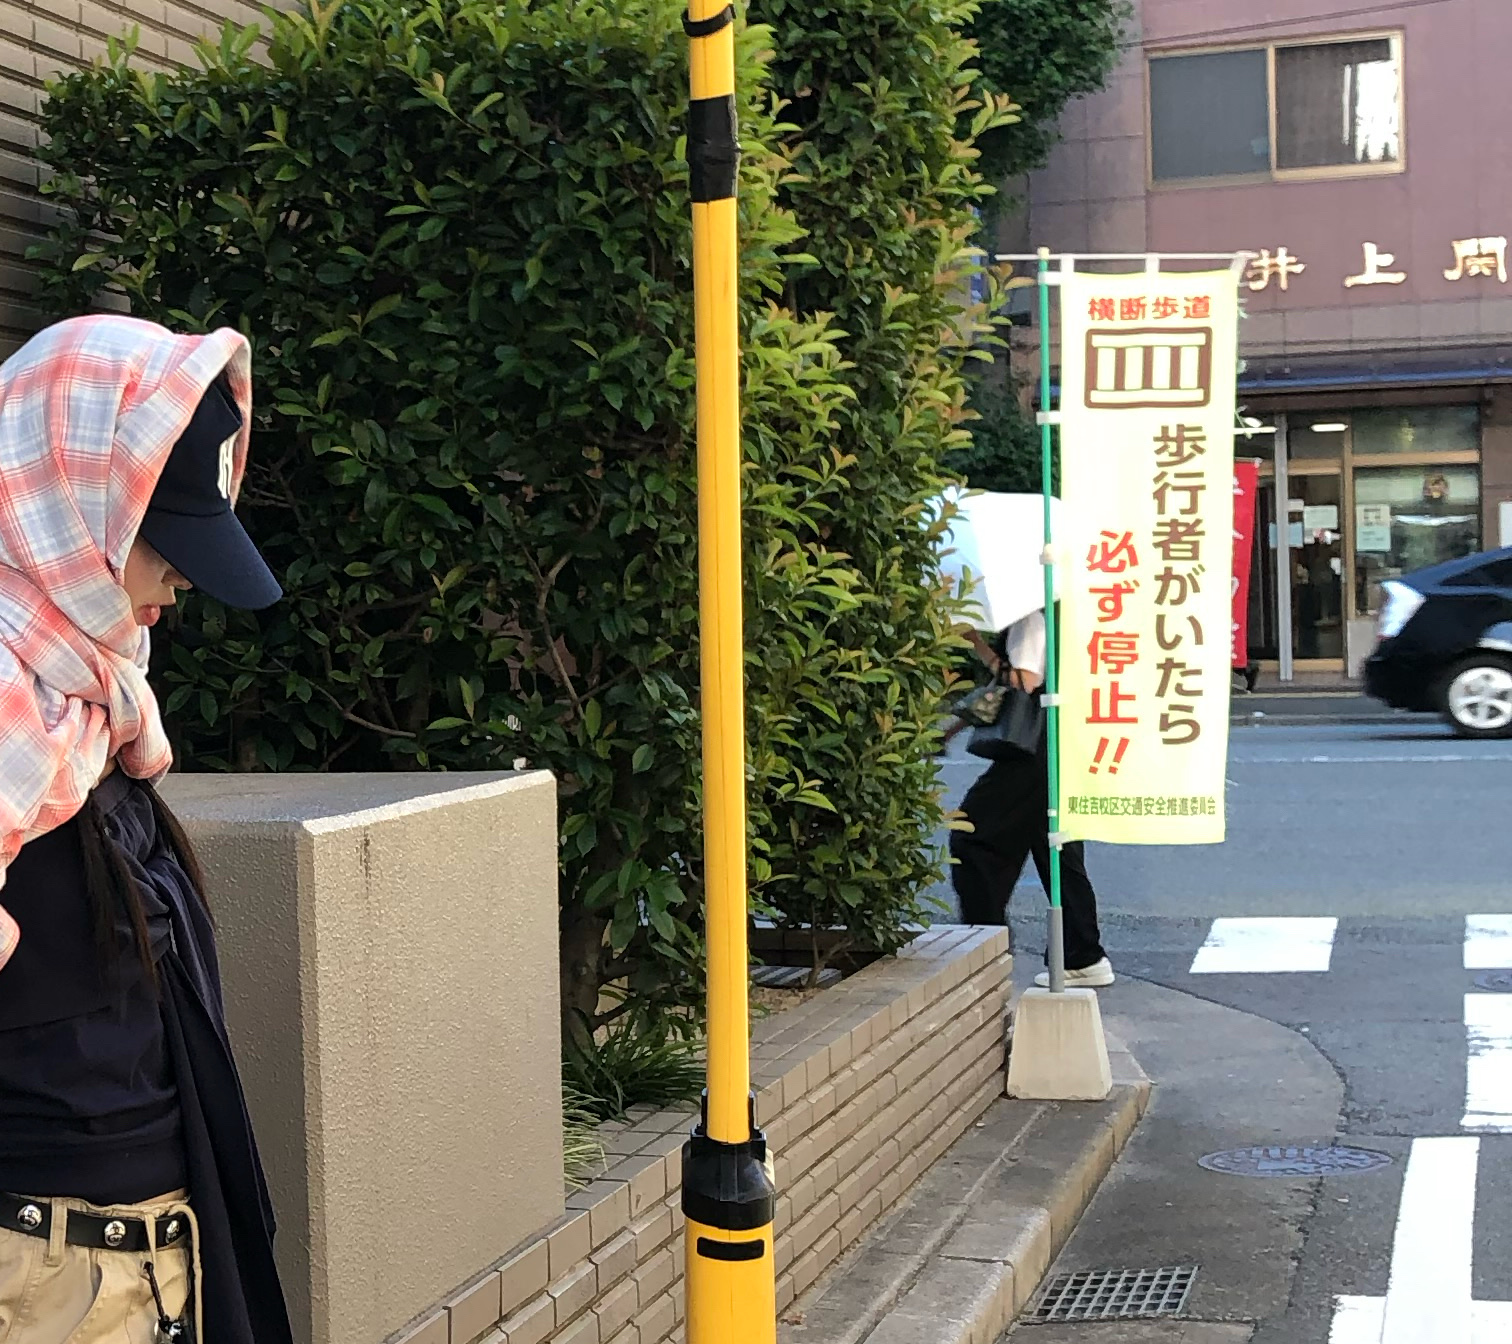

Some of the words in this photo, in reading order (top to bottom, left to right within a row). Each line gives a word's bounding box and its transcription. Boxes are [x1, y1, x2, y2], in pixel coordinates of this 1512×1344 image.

[1088, 295, 1210, 321] 横断歩道
[1086, 530, 1140, 775] 必ず停止!!
[1153, 424, 1207, 745] 歩行者がいたら
